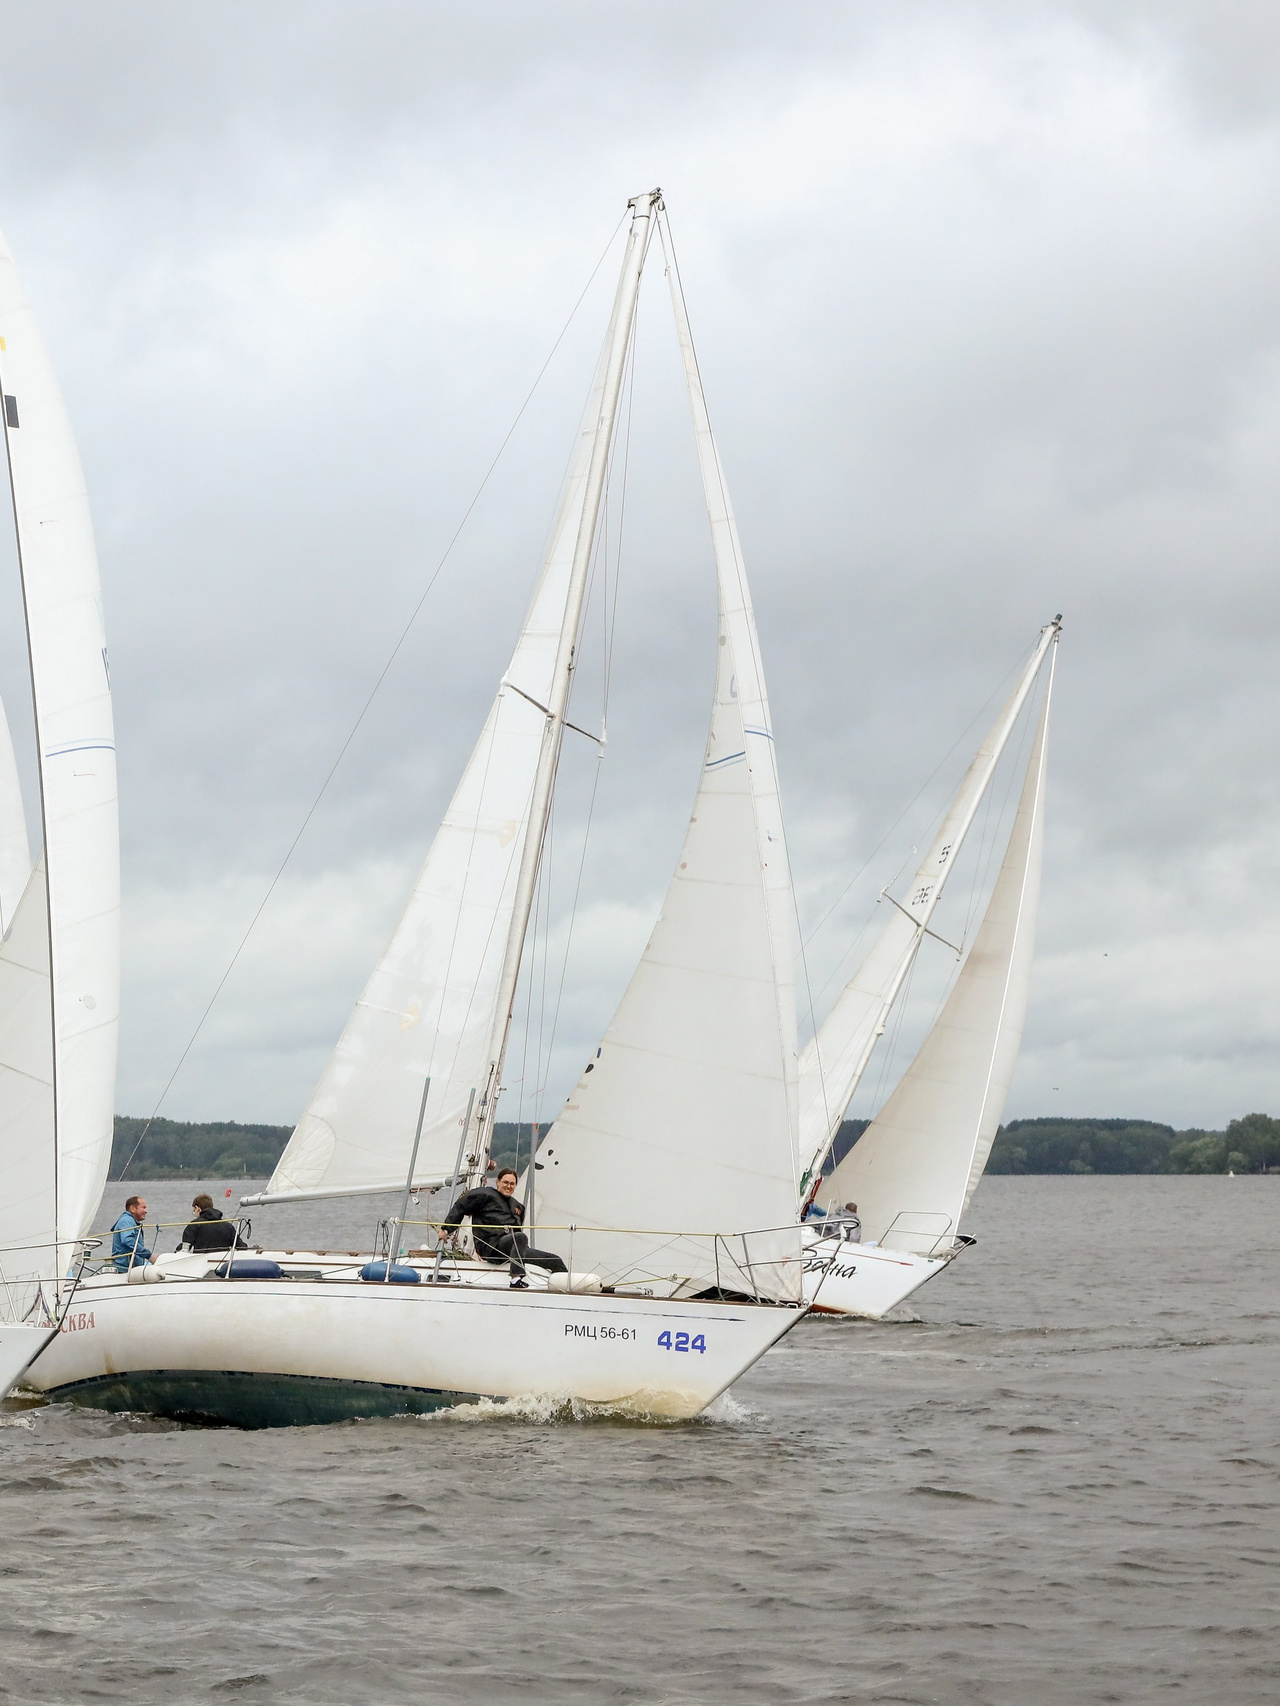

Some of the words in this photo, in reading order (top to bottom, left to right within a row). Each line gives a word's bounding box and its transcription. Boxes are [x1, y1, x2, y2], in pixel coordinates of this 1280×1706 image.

[564, 1324, 597, 1340] РМЦ
[600, 1327, 637, 1340] 56-61
[657, 1330, 707, 1354] 424
